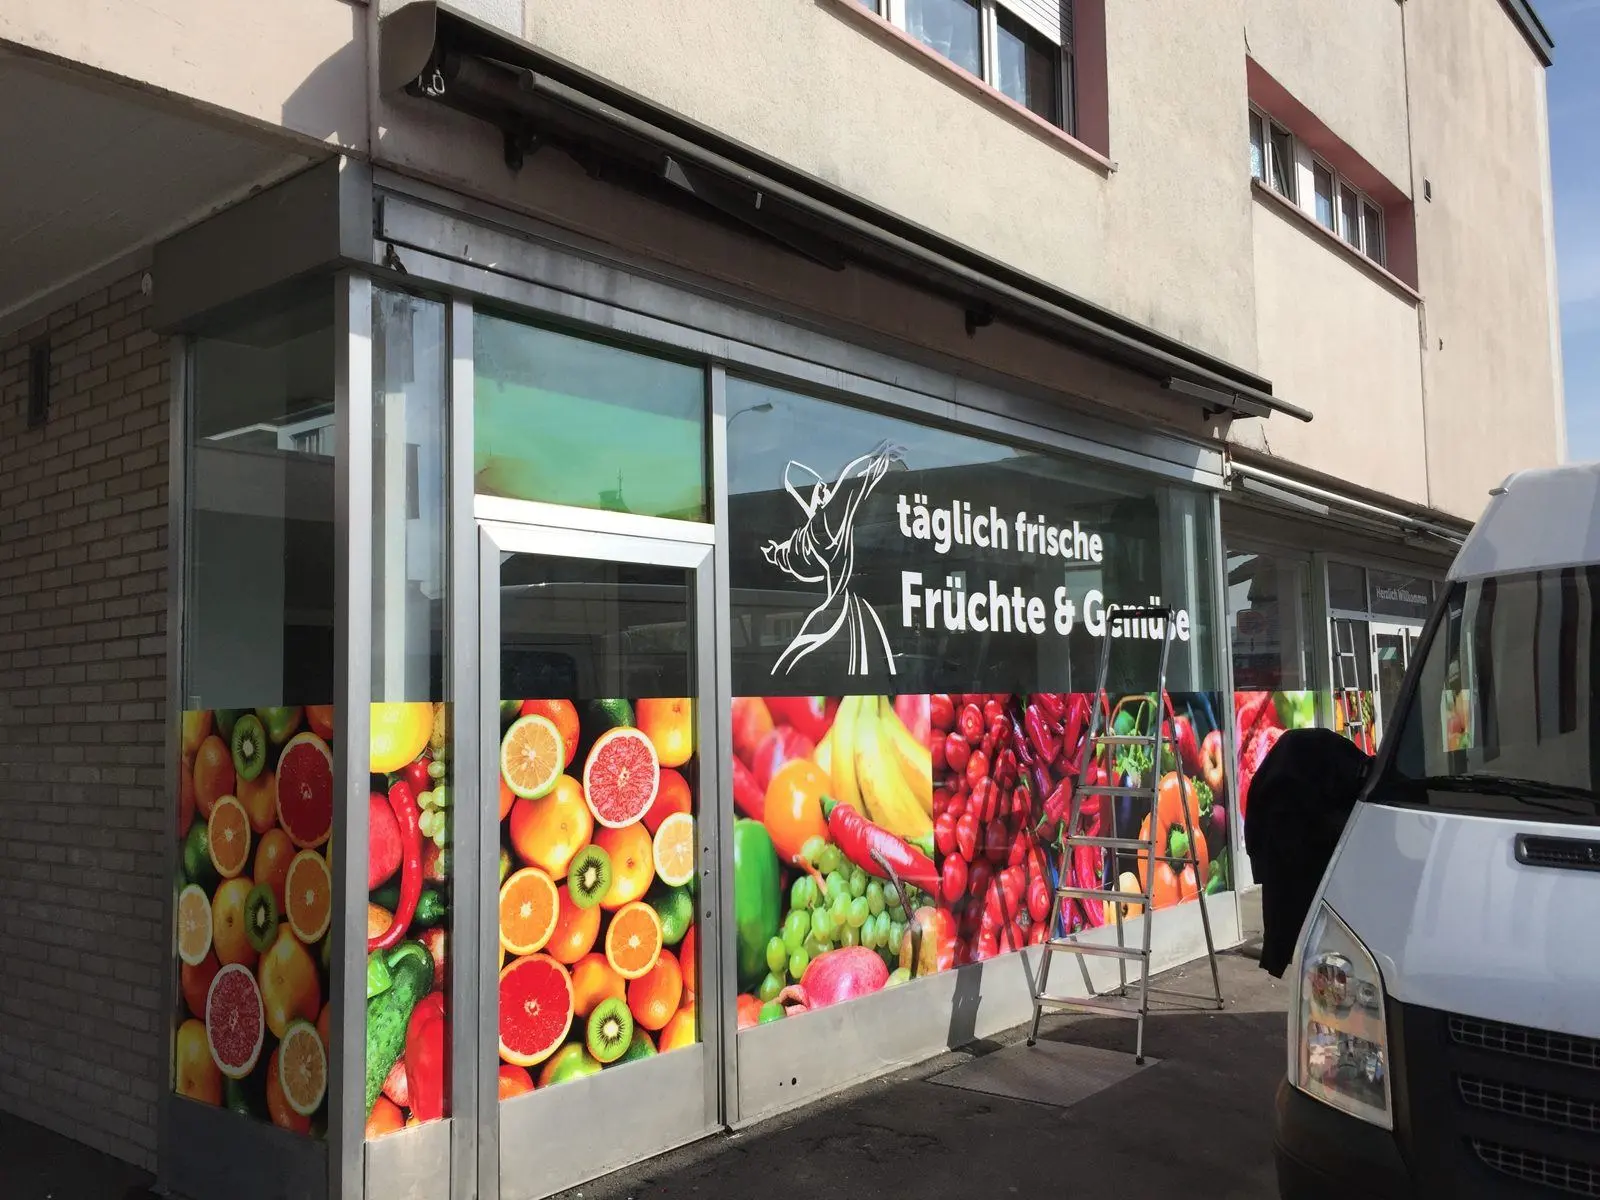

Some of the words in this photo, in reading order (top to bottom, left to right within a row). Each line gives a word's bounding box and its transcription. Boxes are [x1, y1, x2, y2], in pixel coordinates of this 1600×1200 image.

[897, 493, 1009, 554] täglich
[1015, 511, 1103, 563] frische
[901, 570, 1047, 635] Früchte
[1053, 585, 1076, 636] &
